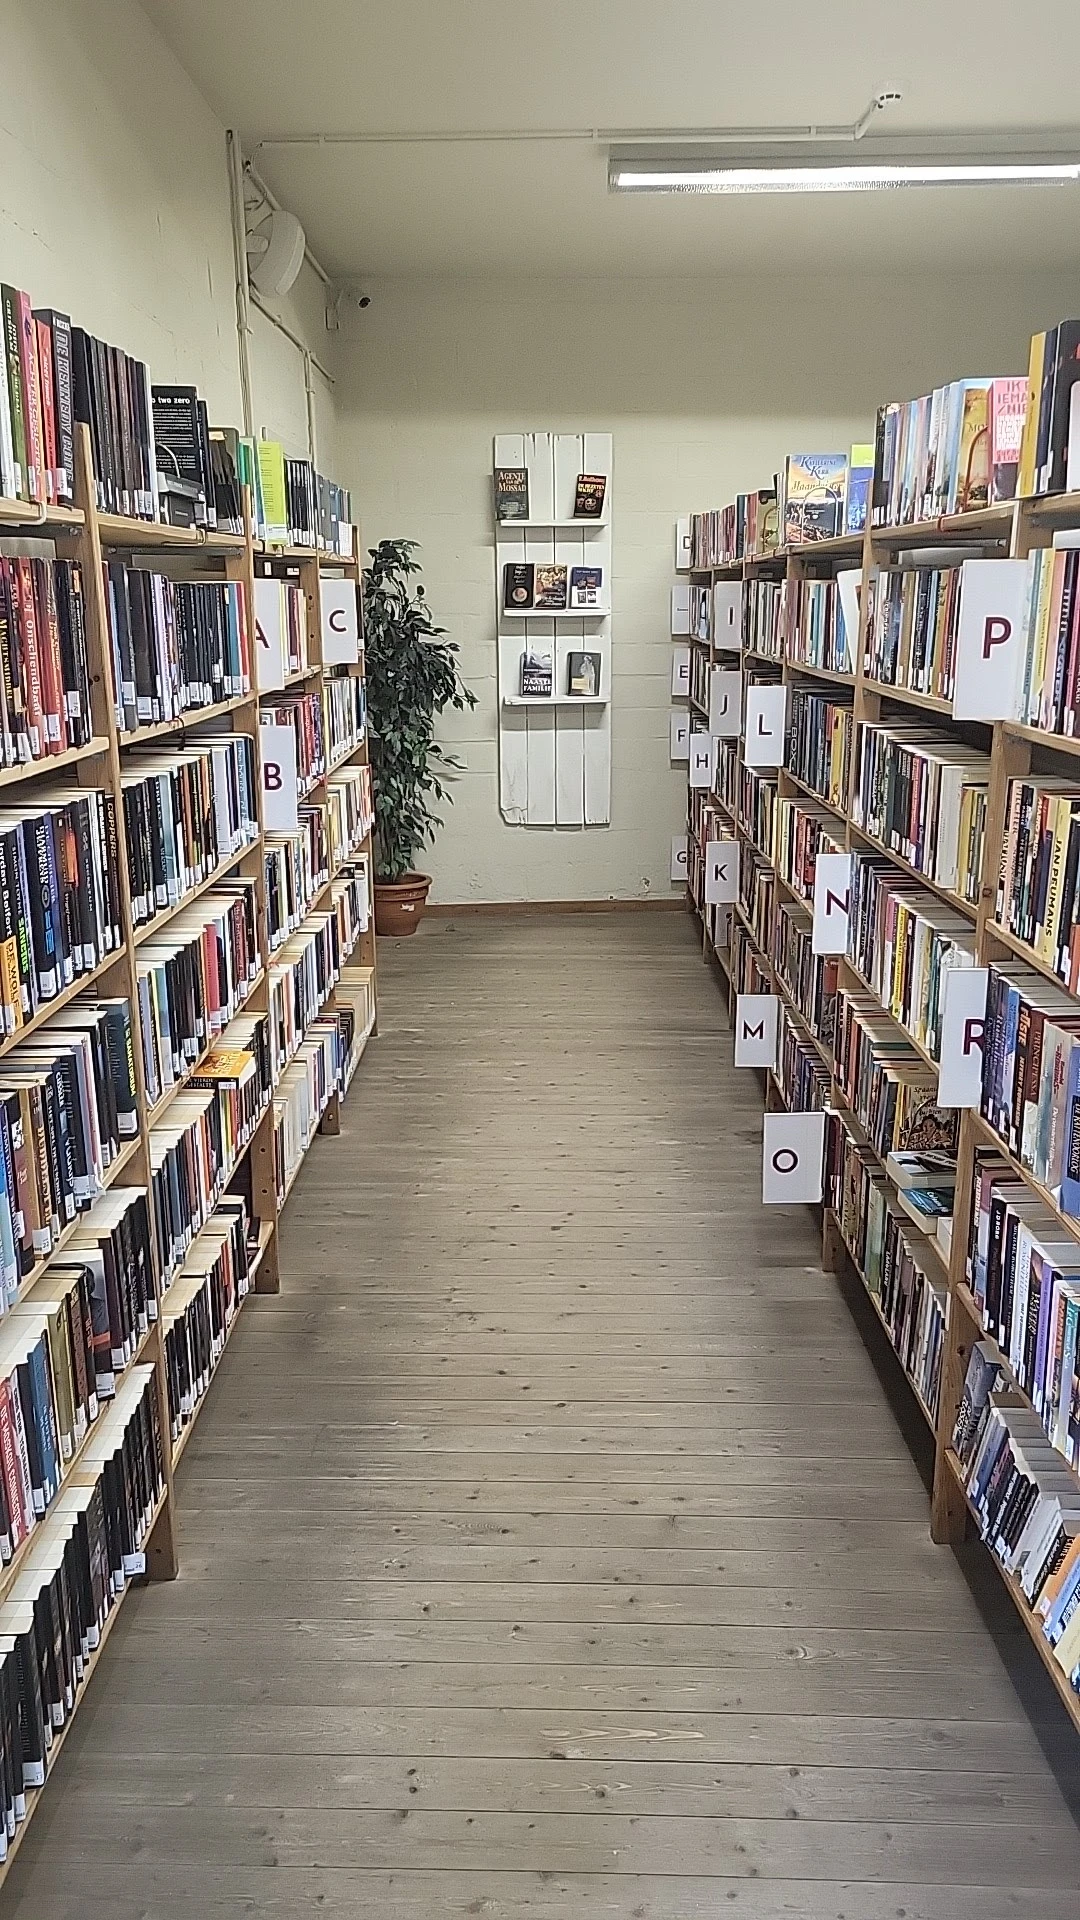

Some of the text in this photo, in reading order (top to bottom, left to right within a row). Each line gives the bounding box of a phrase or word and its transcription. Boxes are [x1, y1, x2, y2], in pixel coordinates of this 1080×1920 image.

[56, 332, 68, 354] DE
[58, 357, 70, 433] KENNEDY
[328, 609, 347, 632] C
[983, 616, 1012, 659] P
[680, 665, 689, 678] E
[719, 694, 728, 716] J
[678, 729, 687, 742] F
[758, 713, 773, 736] L
[696, 753, 709, 769] H
[263, 762, 283, 791] B
[107, 803, 116, 857] COPPERS
[714, 864, 728, 882] K
[1045, 838, 1062, 936] JAN PEUMANS
[826, 888, 850, 916] N
[743, 1019, 765, 1040] M
[962, 1018, 985, 1056] R
[772, 1148, 799, 1174] O
